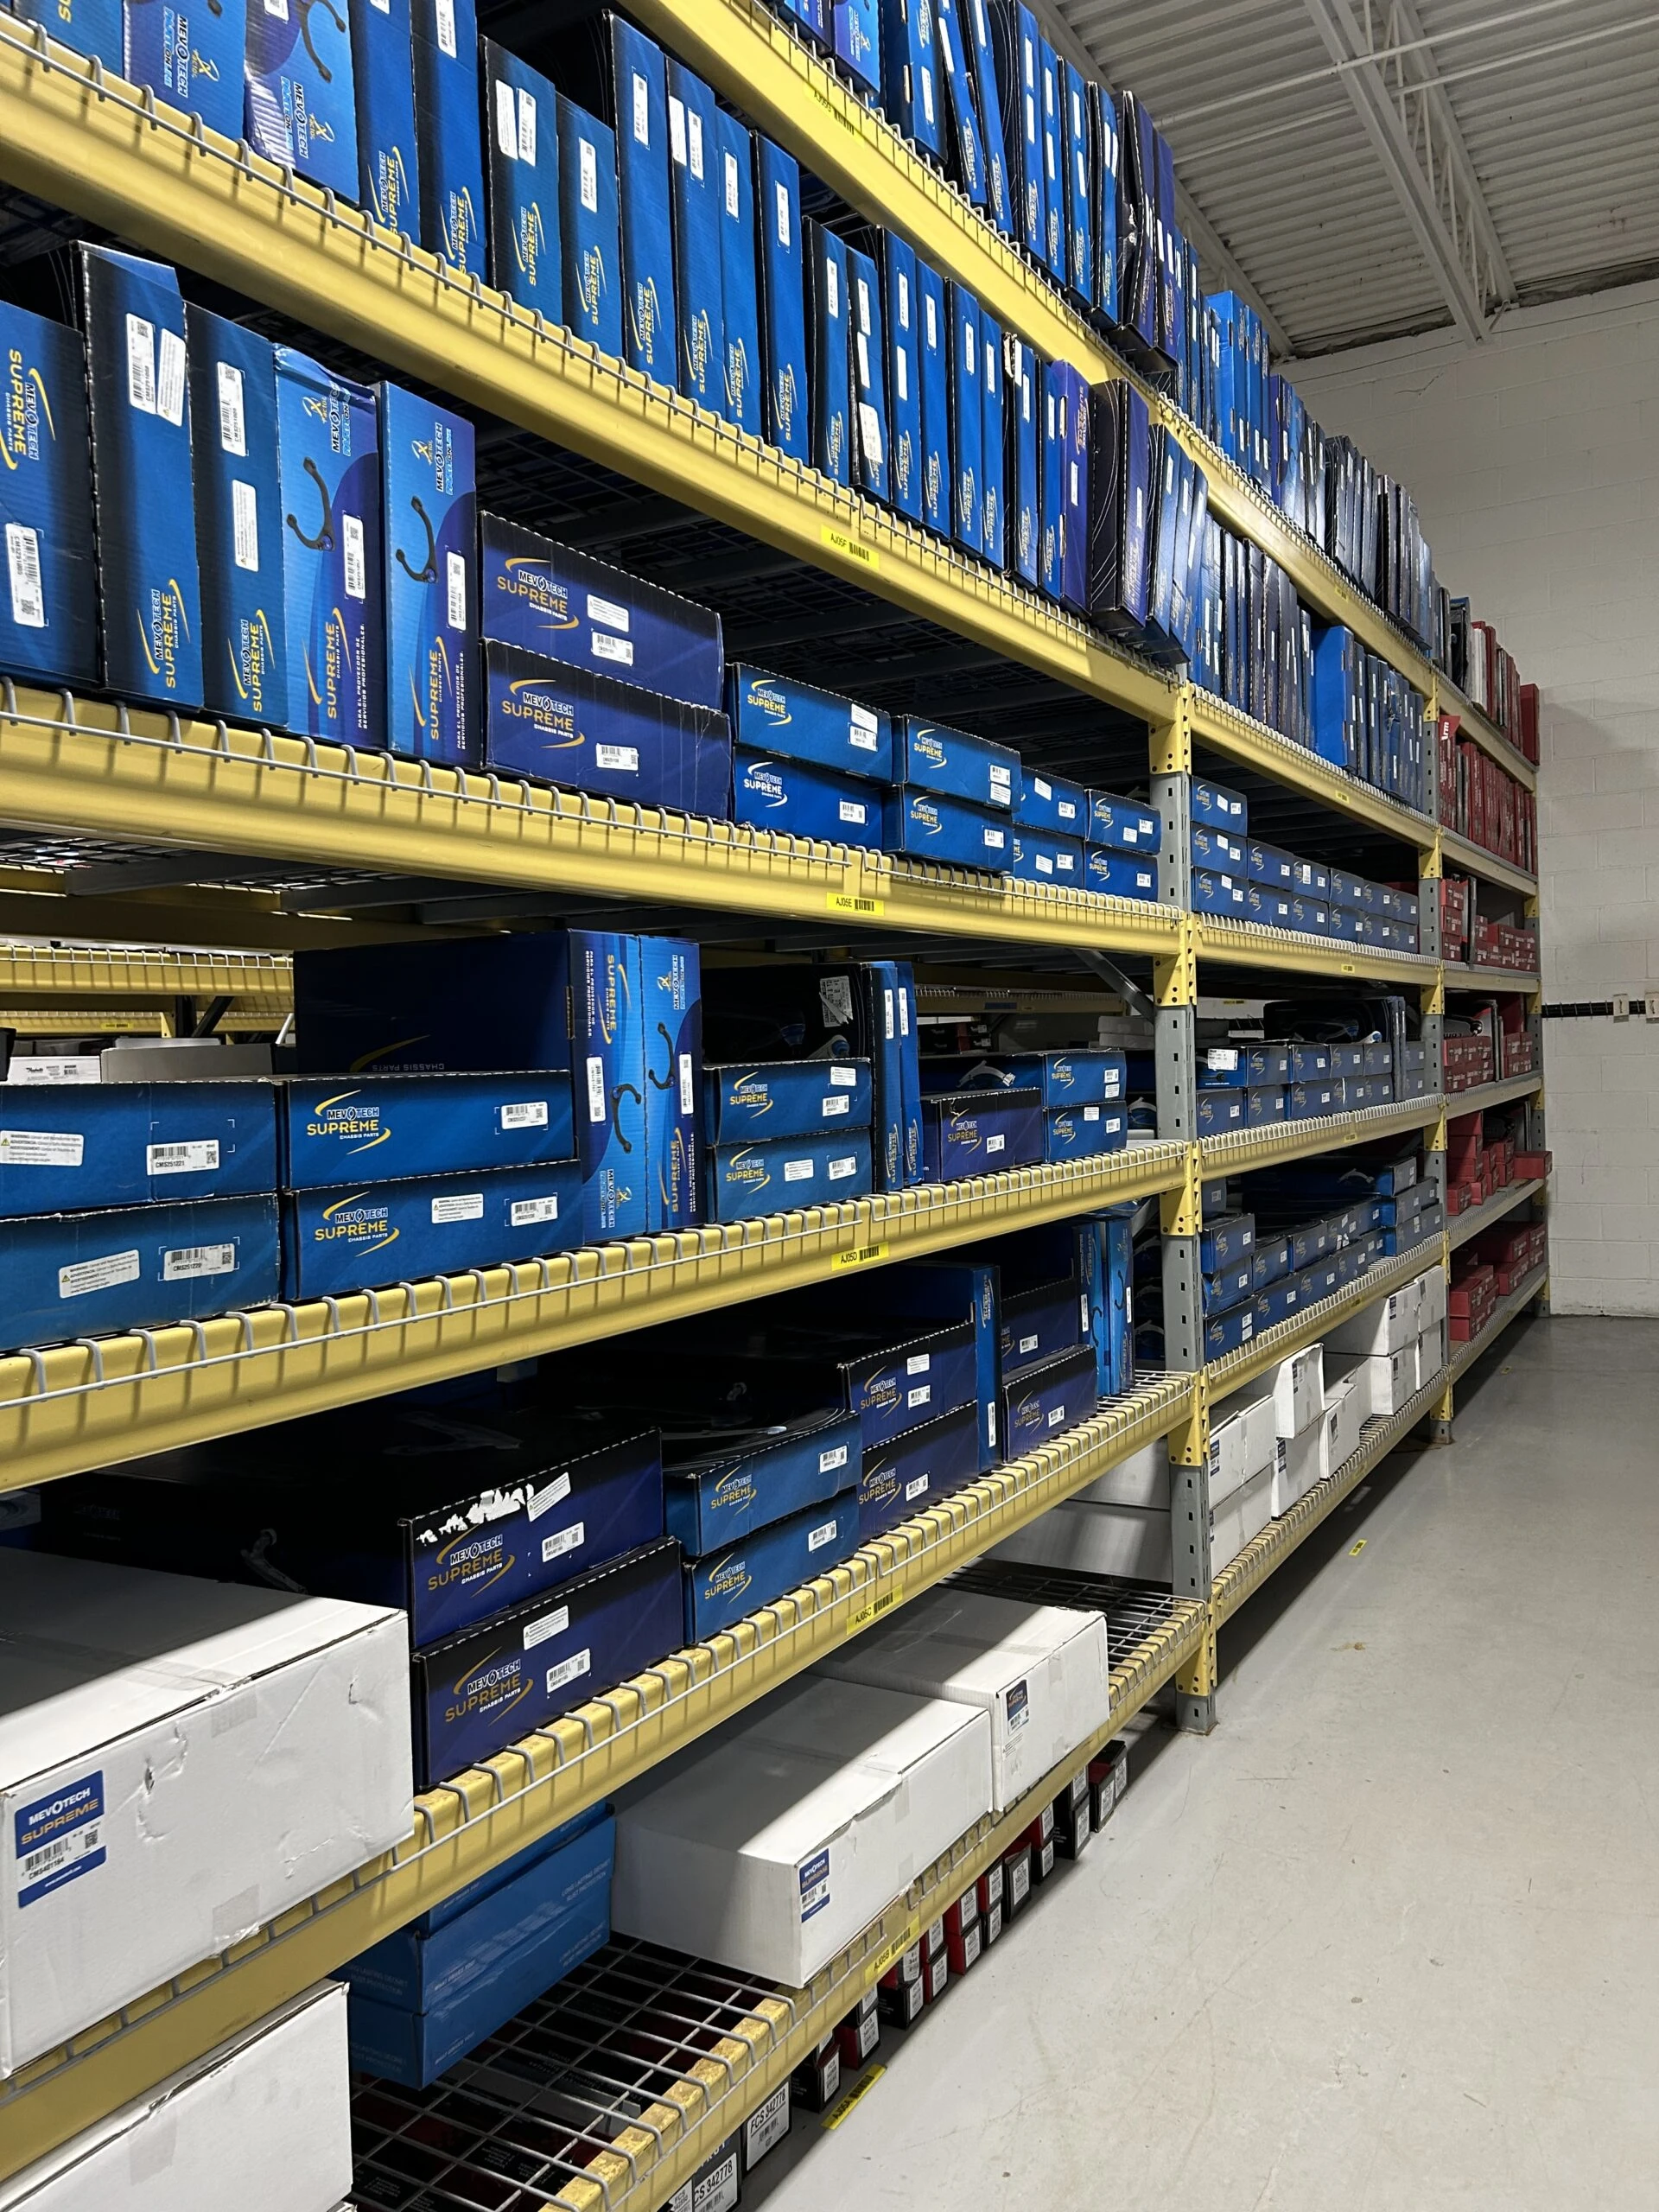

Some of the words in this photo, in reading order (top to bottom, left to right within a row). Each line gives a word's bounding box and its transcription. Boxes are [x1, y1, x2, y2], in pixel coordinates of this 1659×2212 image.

[175, 14, 189, 99] MEVOTECH
[291, 81, 308, 159] MEVOTECH
[379, 150, 388, 213] MEVOTECH
[387, 156, 398, 234] SUPREME
[457, 198, 467, 273] SUPREME
[527, 211, 536, 286] SUPREME
[590, 255, 599, 326] SUPREME
[644, 287, 653, 365] SUPREME
[734, 347, 743, 419] SUPREME
[10, 348, 27, 455] SUPREME
[25, 383, 40, 461] MEVOTECH
[435, 422, 444, 492] MEVOTECH
[830, 533, 847, 547] AJ05F
[497, 575, 568, 614] SUPREME
[518, 569, 568, 599] MEVOTECH
[151, 589, 164, 660] MEVOTECH
[162, 593, 175, 689] SUPREME
[241, 620, 251, 686] MEVOTECH
[250, 622, 262, 713] SUPREME
[326, 621, 337, 719] SUPREME
[429, 650, 439, 741] SUPREME
[523, 691, 574, 716] MEVOTECH
[747, 694, 785, 715] SUPREME
[758, 689, 785, 705] MEVOTECH
[501, 700, 574, 732] SUPREME
[913, 743, 943, 758] SUPREME
[743, 778, 782, 795] SUPREME
[754, 771, 782, 785] MEVOTECH
[910, 810, 938, 824] SUPREME
[836, 897, 852, 908] AJ05E
[607, 954, 617, 1031] SUPREME
[729, 1093, 767, 1105] SUPREME
[740, 1083, 767, 1095] MEVOTECH
[307, 1119, 378, 1136] SUPREME
[327, 1106, 379, 1121] MEVOTECH
[947, 1130, 977, 1142] SUPREME
[671, 1140, 679, 1213] SUPREME
[726, 1168, 765, 1181] SUPREME
[736, 1159, 764, 1170] MEVOTECH
[607, 1168, 616, 1229] MEVOTECH
[315, 1221, 388, 1241] SUPREME
[335, 1207, 388, 1224] MEVOTECH
[841, 1252, 858, 1264] AJ05D
[860, 1389, 897, 1409] SUPREME
[1014, 1409, 1040, 1428] SUPREME
[711, 1485, 752, 1510] SUPREME
[722, 1474, 752, 1493] MEVOTECH
[859, 1478, 896, 1505] SUPREME
[449, 1534, 503, 1566] MEVOTECH
[428, 1549, 503, 1591] SUPREME
[486, 1562, 503, 1577] PARTS
[715, 1561, 746, 1582] MEVOTECH
[704, 1572, 745, 1599] SUPREME
[855, 1607, 872, 1624] AJ05C
[467, 1659, 521, 1696] MEVOTECH
[445, 1674, 520, 1723] SUPREME
[504, 1688, 521, 1703] PARTS
[29, 1787, 91, 1826] MEVOTECH
[21, 1799, 99, 1846] SUPREME
[874, 1948, 890, 1971] AJ05B
[750, 2113, 764, 2134] FCS
[764, 2088, 787, 2120] 342778
[695, 2185, 705, 2203] CS
[707, 2160, 733, 2193] 342778
